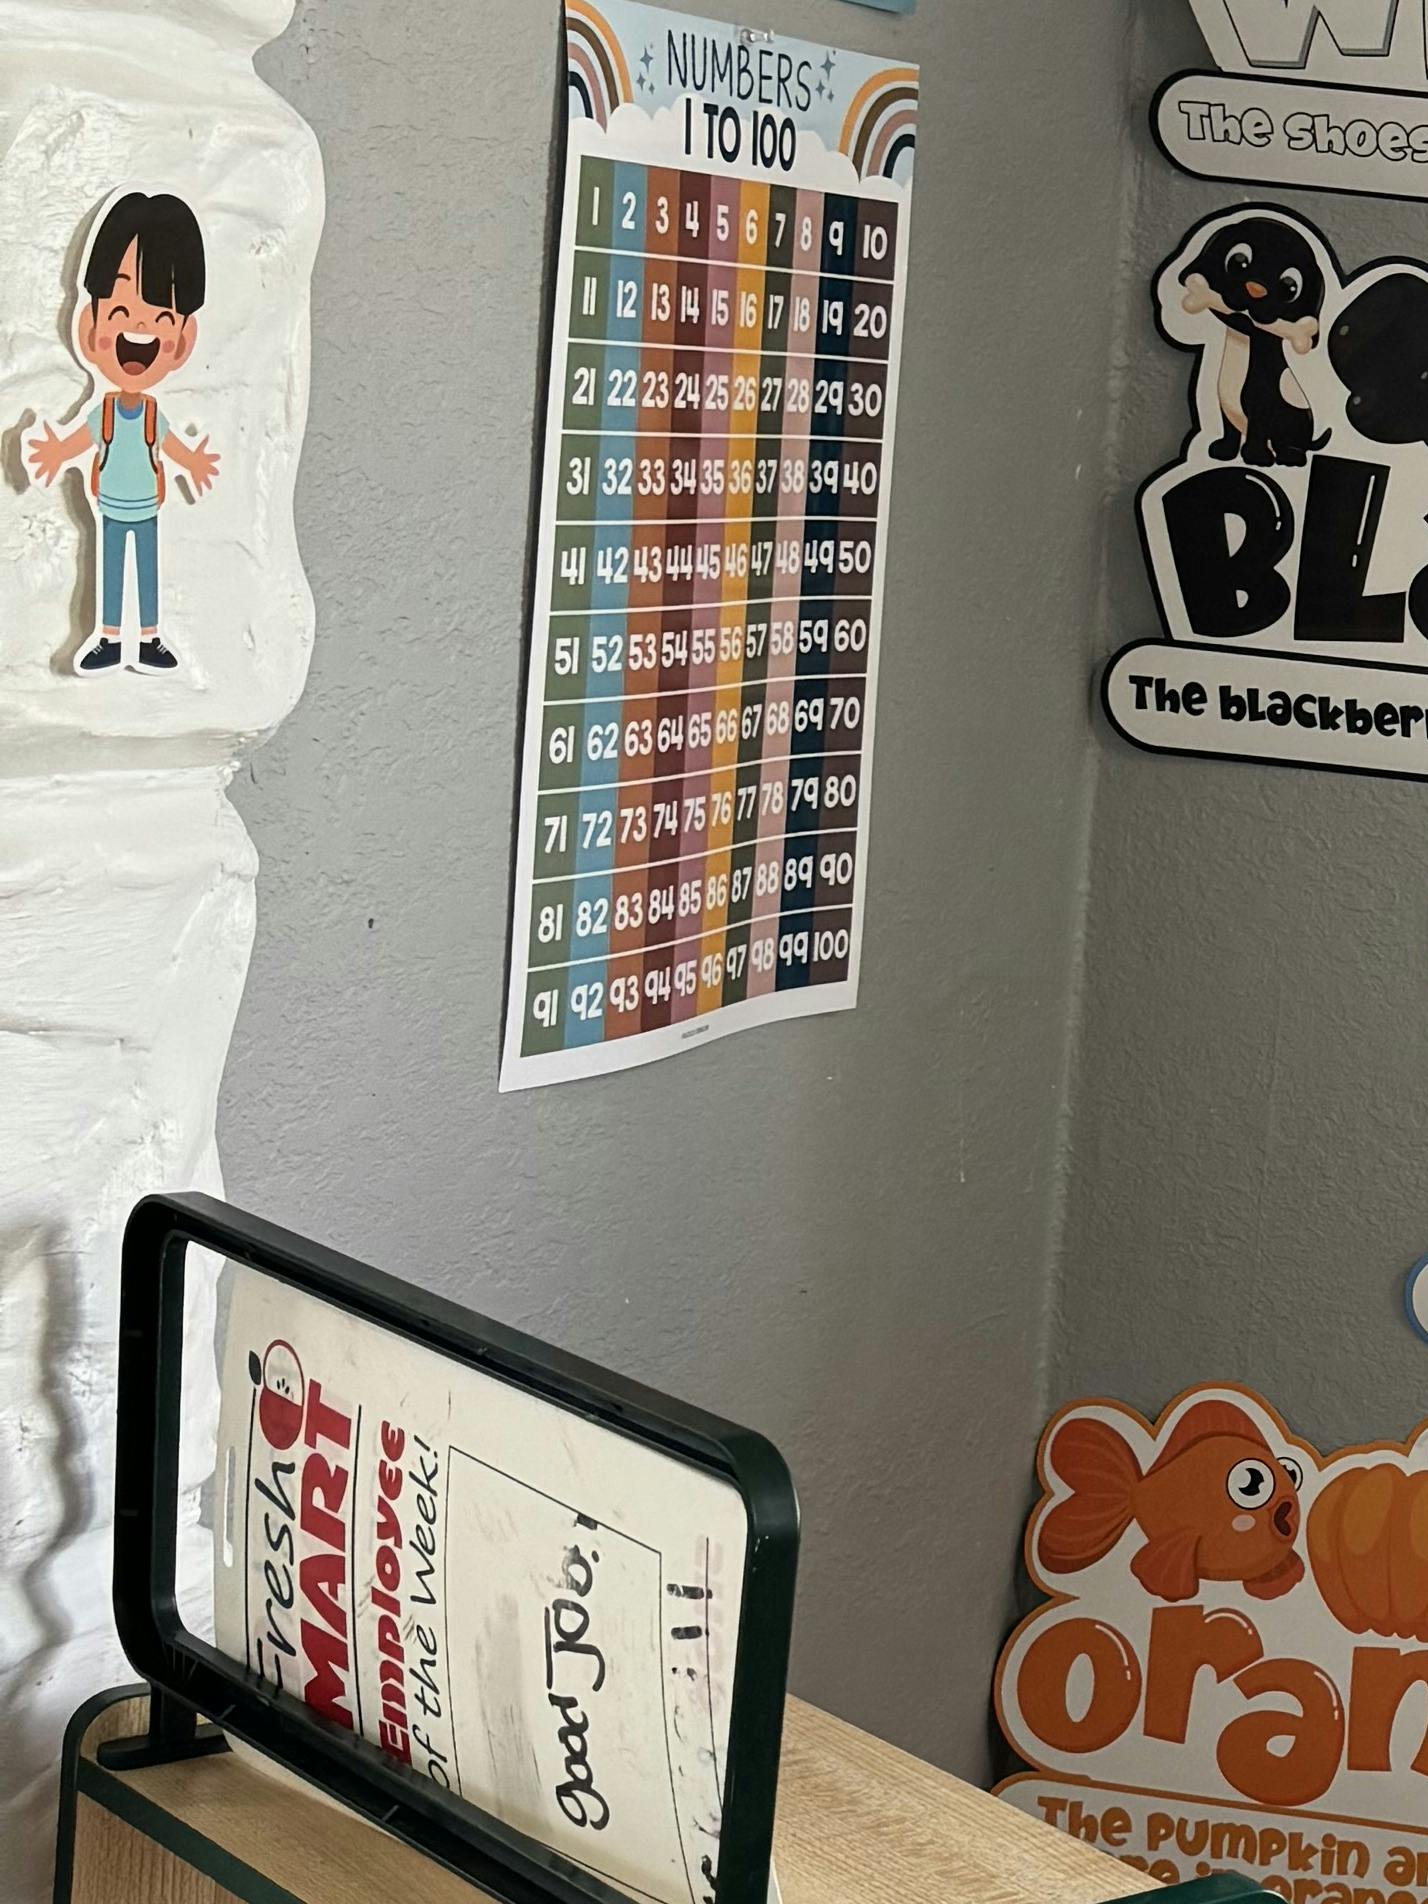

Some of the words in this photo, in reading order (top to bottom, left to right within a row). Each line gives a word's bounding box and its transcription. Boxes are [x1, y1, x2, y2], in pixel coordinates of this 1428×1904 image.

[667, 29, 812, 112] NUMBERS
[703, 103, 741, 163] TO
[752, 111, 797, 172] 100
[1179, 100, 1274, 149] The
[572, 368, 596, 405] 21
[608, 369, 637, 407] 22
[642, 371, 669, 408] 23
[674, 372, 700, 411] 24
[704, 374, 729, 411] 25
[733, 375, 756, 411] 26
[761, 377, 783, 412] 27
[786, 378, 809, 413] 28
[814, 380, 844, 415] 29
[848, 383, 883, 417] 30
[1128, 674, 1208, 716] The
[300, 1379, 354, 1732] MART
[408, 1434, 439, 1605] Week!
[254, 1462, 296, 1689] Fresh
[408, 1627, 443, 1719] the
[411, 1724, 451, 1790] of
[1037, 1796, 1132, 1847] The
[1146, 1809, 1371, 1881] pumpkin
